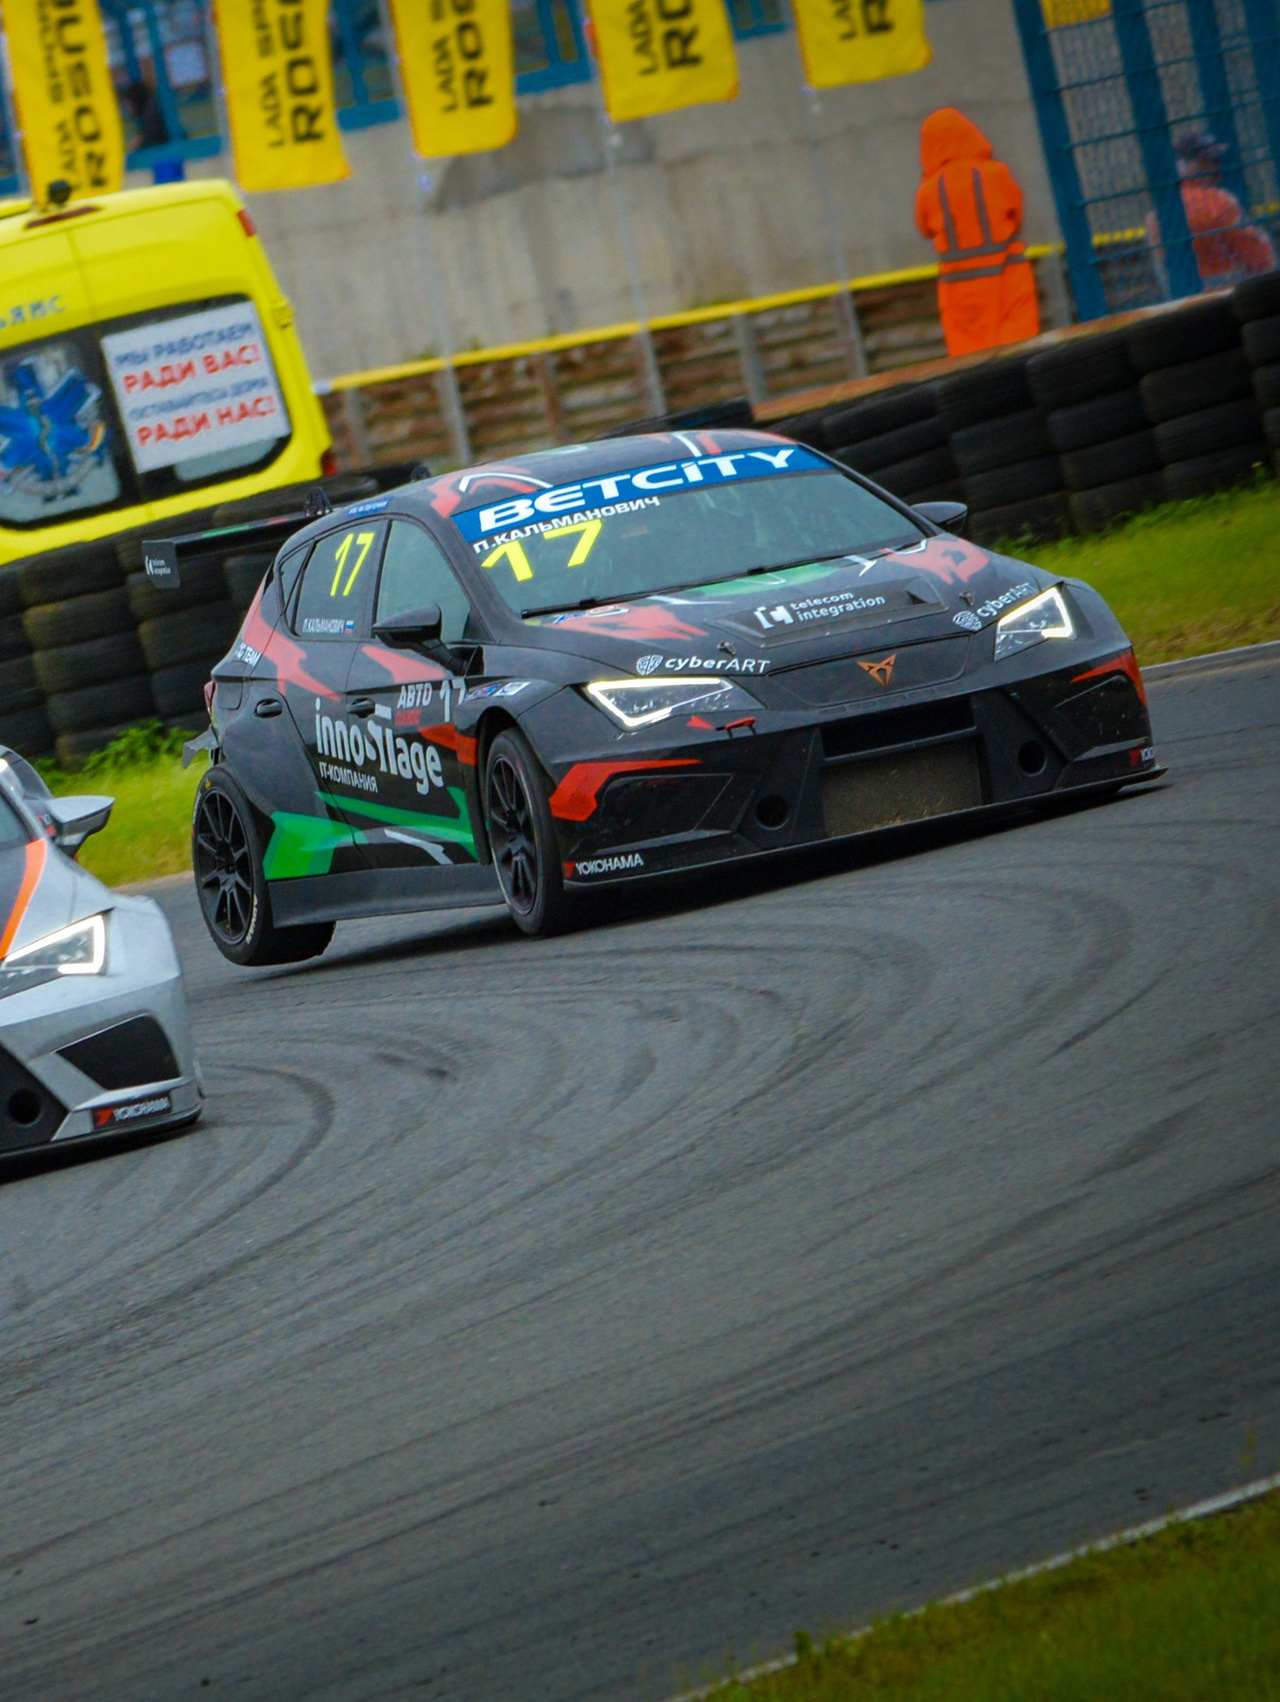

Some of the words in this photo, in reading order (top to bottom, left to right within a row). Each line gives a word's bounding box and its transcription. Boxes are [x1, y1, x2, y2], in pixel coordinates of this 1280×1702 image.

[52, 0, 108, 187] ROSN
[277, 0, 324, 146] ROS
[431, 35, 458, 114] LADA
[258, 71, 286, 148] LADA
[123, 360, 196, 394] РАДИ
[202, 343, 261, 374] ВАС!
[136, 412, 211, 447] РАДИ
[216, 396, 275, 426] НАС!
[473, 497, 660, 554] П.КАЛЬМАНОВИЧ
[480, 519, 602, 582] 17
[330, 532, 374, 596] 17
[790, 591, 853, 613] telecom
[796, 595, 885, 621] integration
[977, 582, 1035, 617] cyberART
[664, 655, 771, 674] cyberART
[397, 682, 433, 709] АВТО
[576, 853, 644, 875] YOKOHAMA
[113, 1096, 171, 1121] YOKOHAMA
